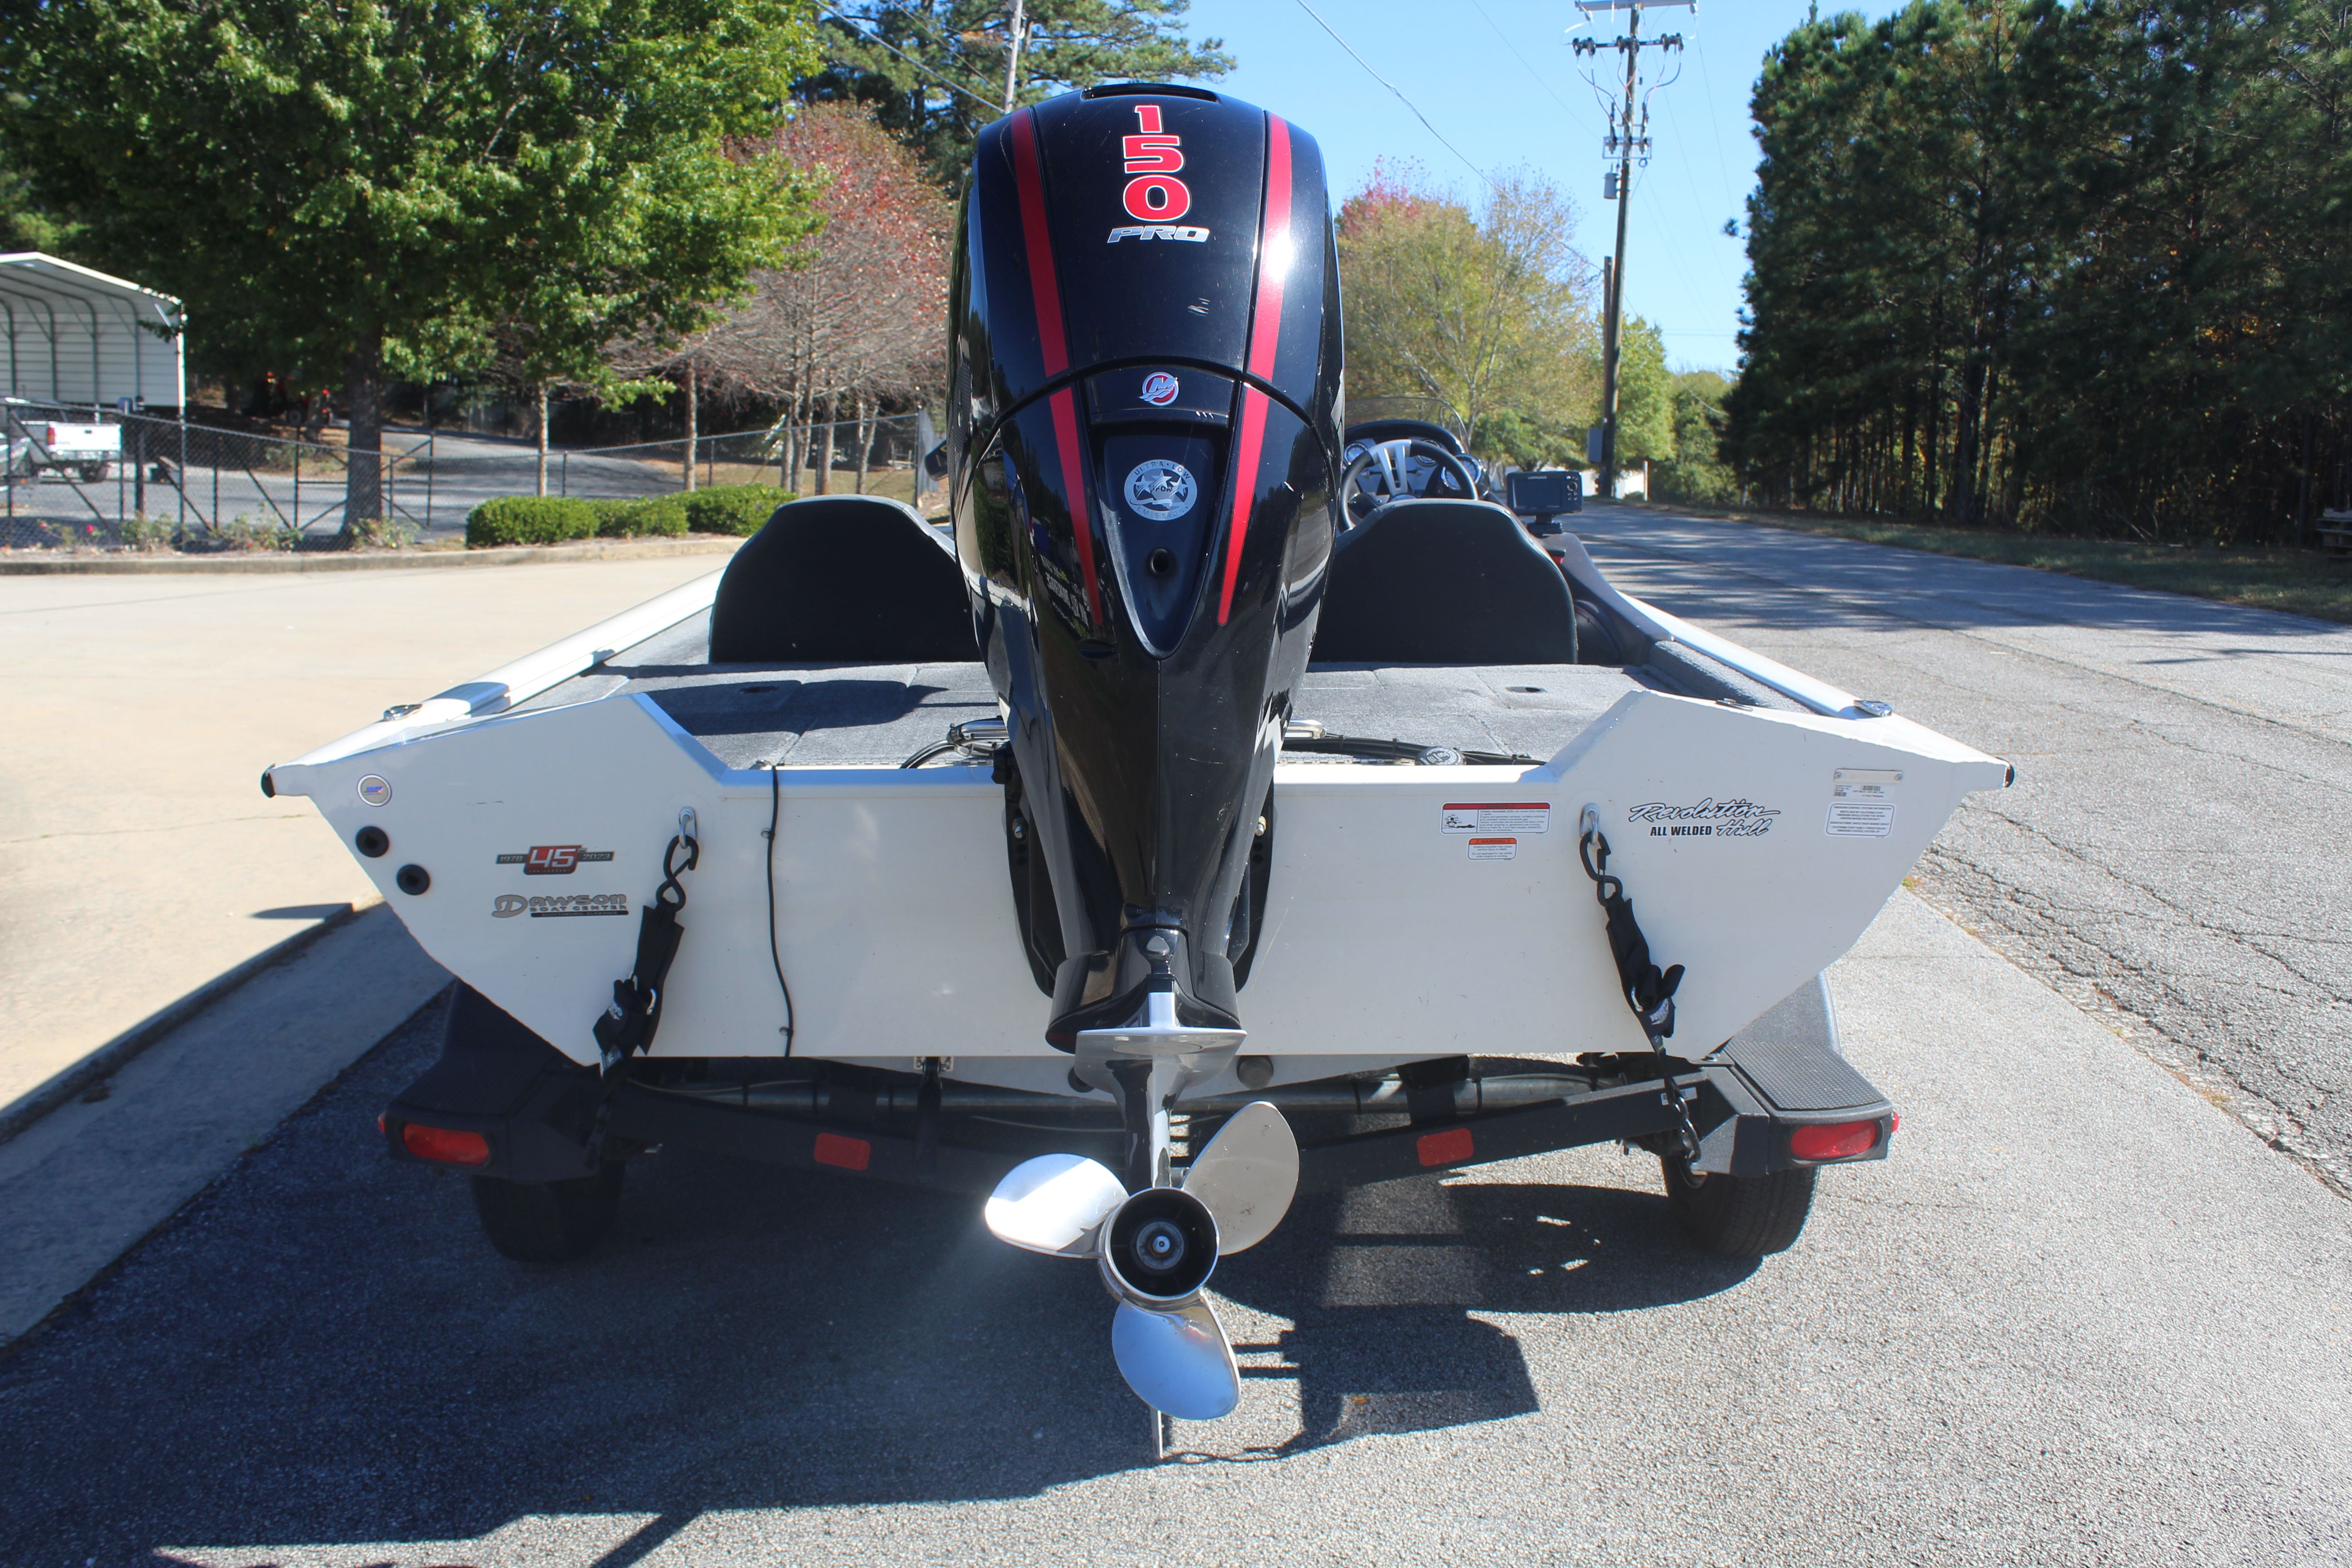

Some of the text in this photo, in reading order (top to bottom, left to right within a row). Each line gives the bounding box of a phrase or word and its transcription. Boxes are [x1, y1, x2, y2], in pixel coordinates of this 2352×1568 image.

[1122, 105, 1191, 222] 150
[1107, 225, 1210, 243] PRO
[1134, 461, 1191, 479] ULTRA LOW
[1137, 506, 1185, 519] EMISSION
[1628, 797, 1781, 823] Revolution
[1650, 818, 1773, 836] ALL WELDED Hull
[529, 848, 576, 867] 45
[491, 894, 627, 918] Dawson
